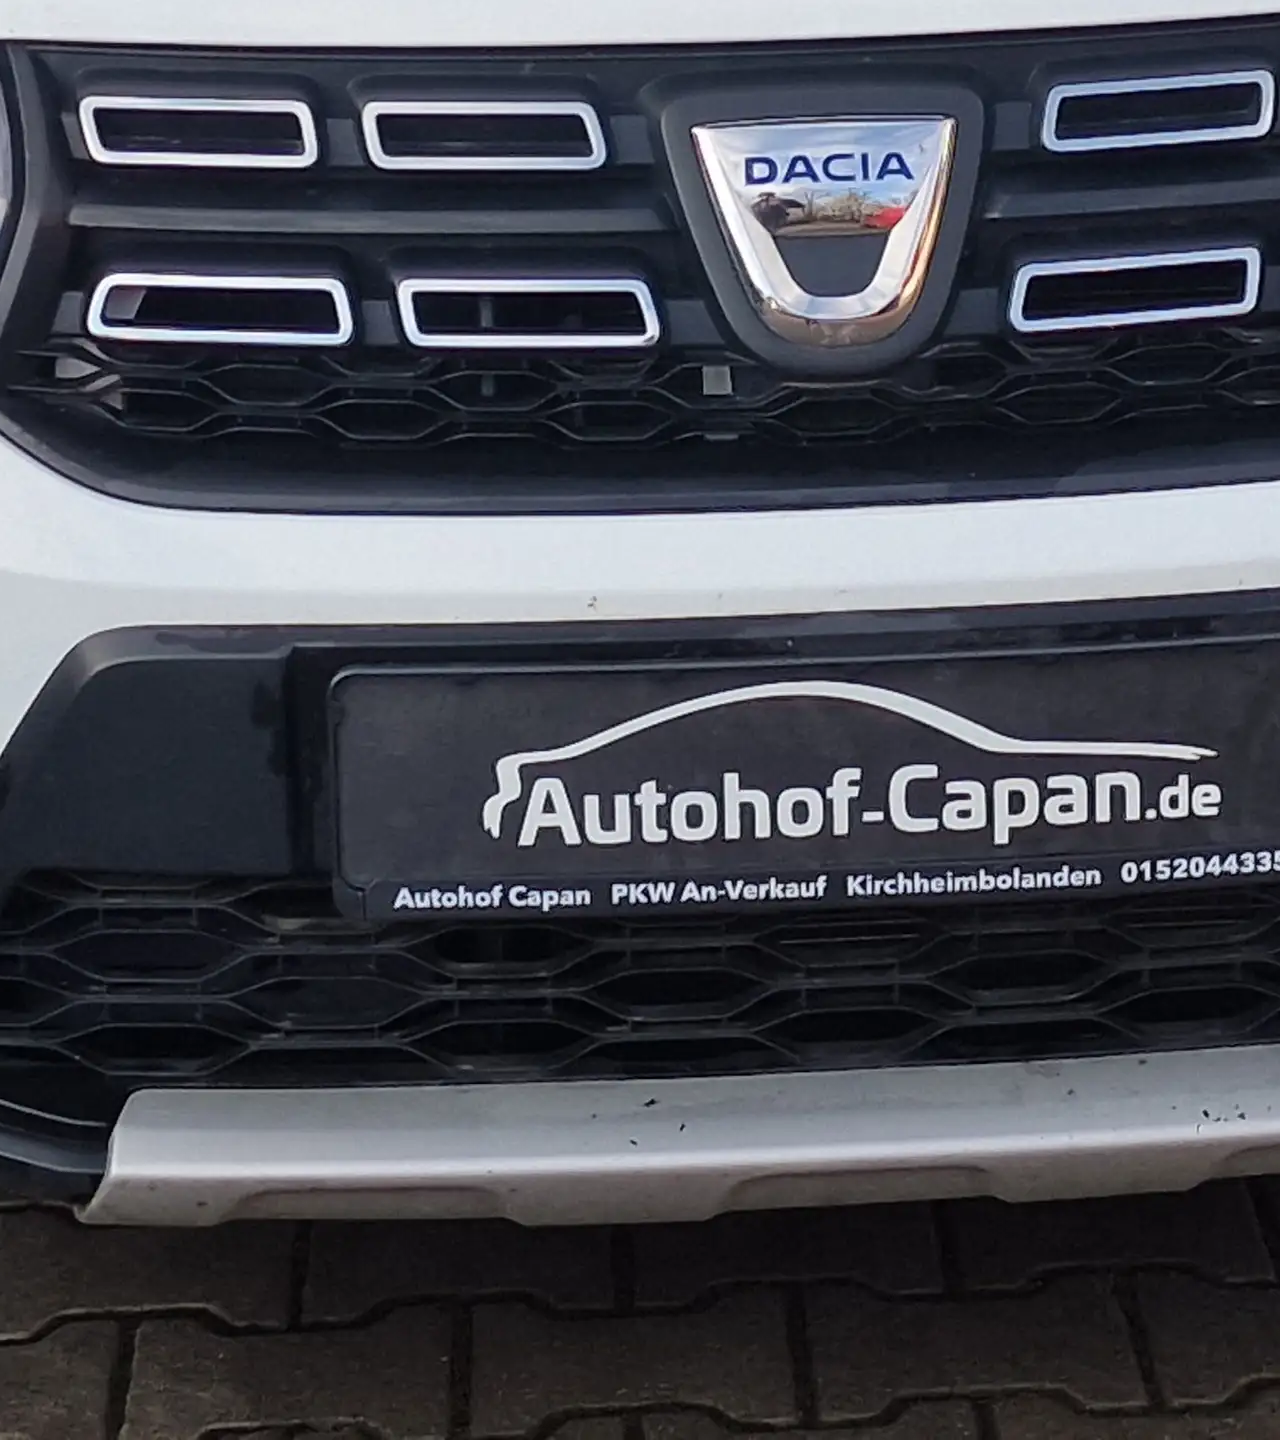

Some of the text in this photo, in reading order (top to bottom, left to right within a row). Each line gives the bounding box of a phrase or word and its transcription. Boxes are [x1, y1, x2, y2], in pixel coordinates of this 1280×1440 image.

[744, 151, 915, 186] DACIA
[517, 764, 1222, 847] Autohof-Capan.de
[393, 885, 505, 910] Autohof
[508, 886, 592, 912] Capan
[611, 881, 676, 905] PKW
[680, 875, 828, 903] An-Verkauf
[846, 866, 1103, 897] Kirchheimbolanden
